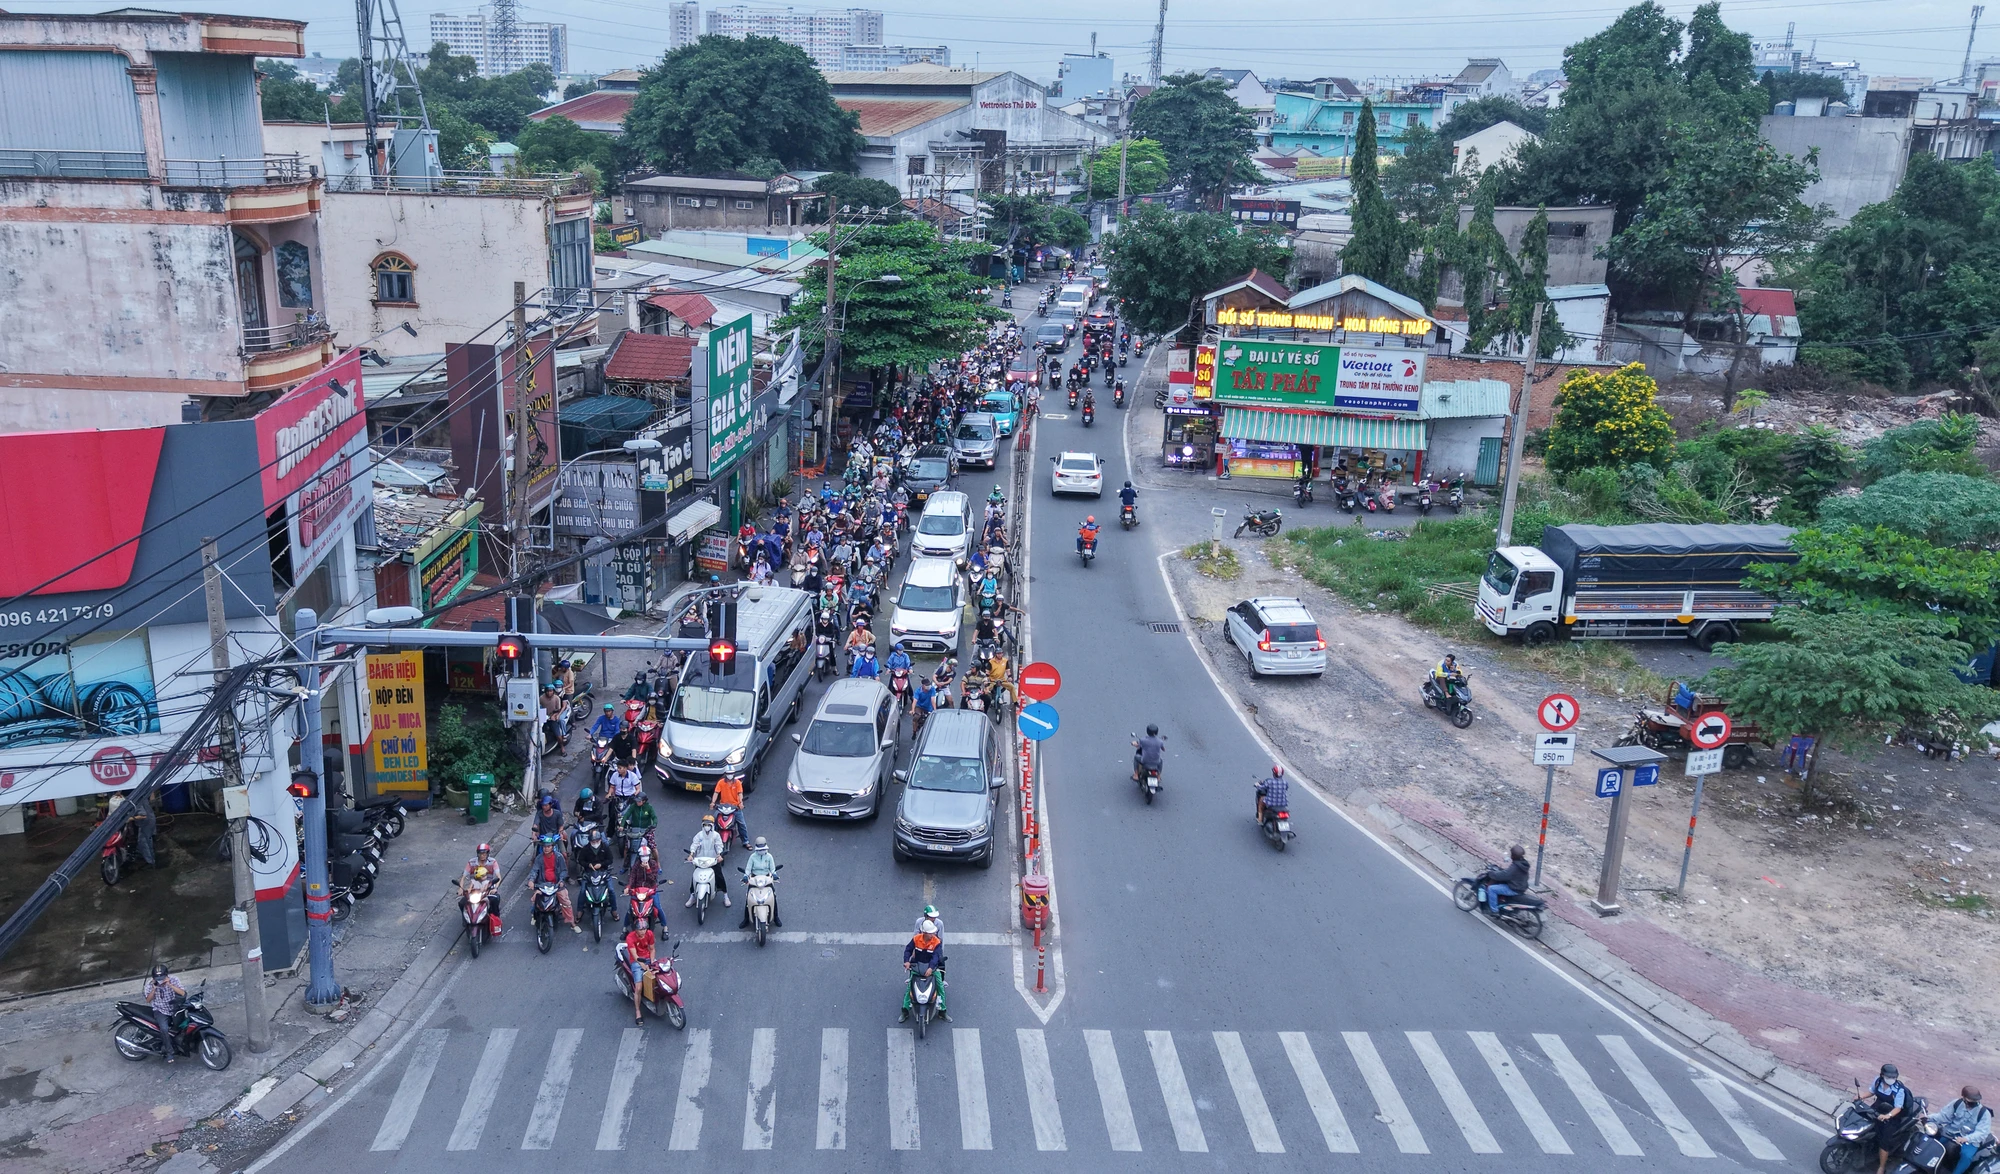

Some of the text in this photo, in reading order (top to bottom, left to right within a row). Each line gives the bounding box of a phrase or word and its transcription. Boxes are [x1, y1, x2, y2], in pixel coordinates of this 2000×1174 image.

[1012, 100, 1024, 108] Thủ
[1257, 312, 1292, 327] TRÚNG
[1294, 314, 1334, 330] NHANH
[1344, 317, 1366, 331] HOA
[1402, 318, 1431, 335] THẤP
[716, 326, 747, 378] NỆM
[1249, 349, 1321, 365] ĐẠI LÝ VÉ SỐ
[1342, 360, 1393, 371] Vietlott
[1198, 367, 1210, 381] SỐ
[1271, 368, 1321, 393] PHÁT
[1340, 380, 1356, 389] TRUNG
[1359, 381, 1369, 389] TÂM
[1404, 384, 1419, 392] KENO
[711, 382, 736, 436] GIÁ
[739, 368, 751, 418] SỈ
[1344, 399, 1408, 407] vesotanphat.com
[662, 446, 682, 472] Táo
[556, 515, 573, 526] LINH
[623, 545, 641, 560] GÓP
[627, 562, 641, 573] CŨ
[616, 574, 634, 584] CAO
[0, 612, 32, 627] 096
[36, 607, 68, 624] 421
[369, 658, 416, 681] BẢNG HIỆU
[376, 685, 413, 707] HỘP ĐÈN
[374, 714, 390, 730] ALU
[398, 712, 421, 728] MICA
[381, 731, 416, 755] CHỮ NỔI
[403, 755, 419, 768] LED
[1543, 753, 1556, 761] 950
